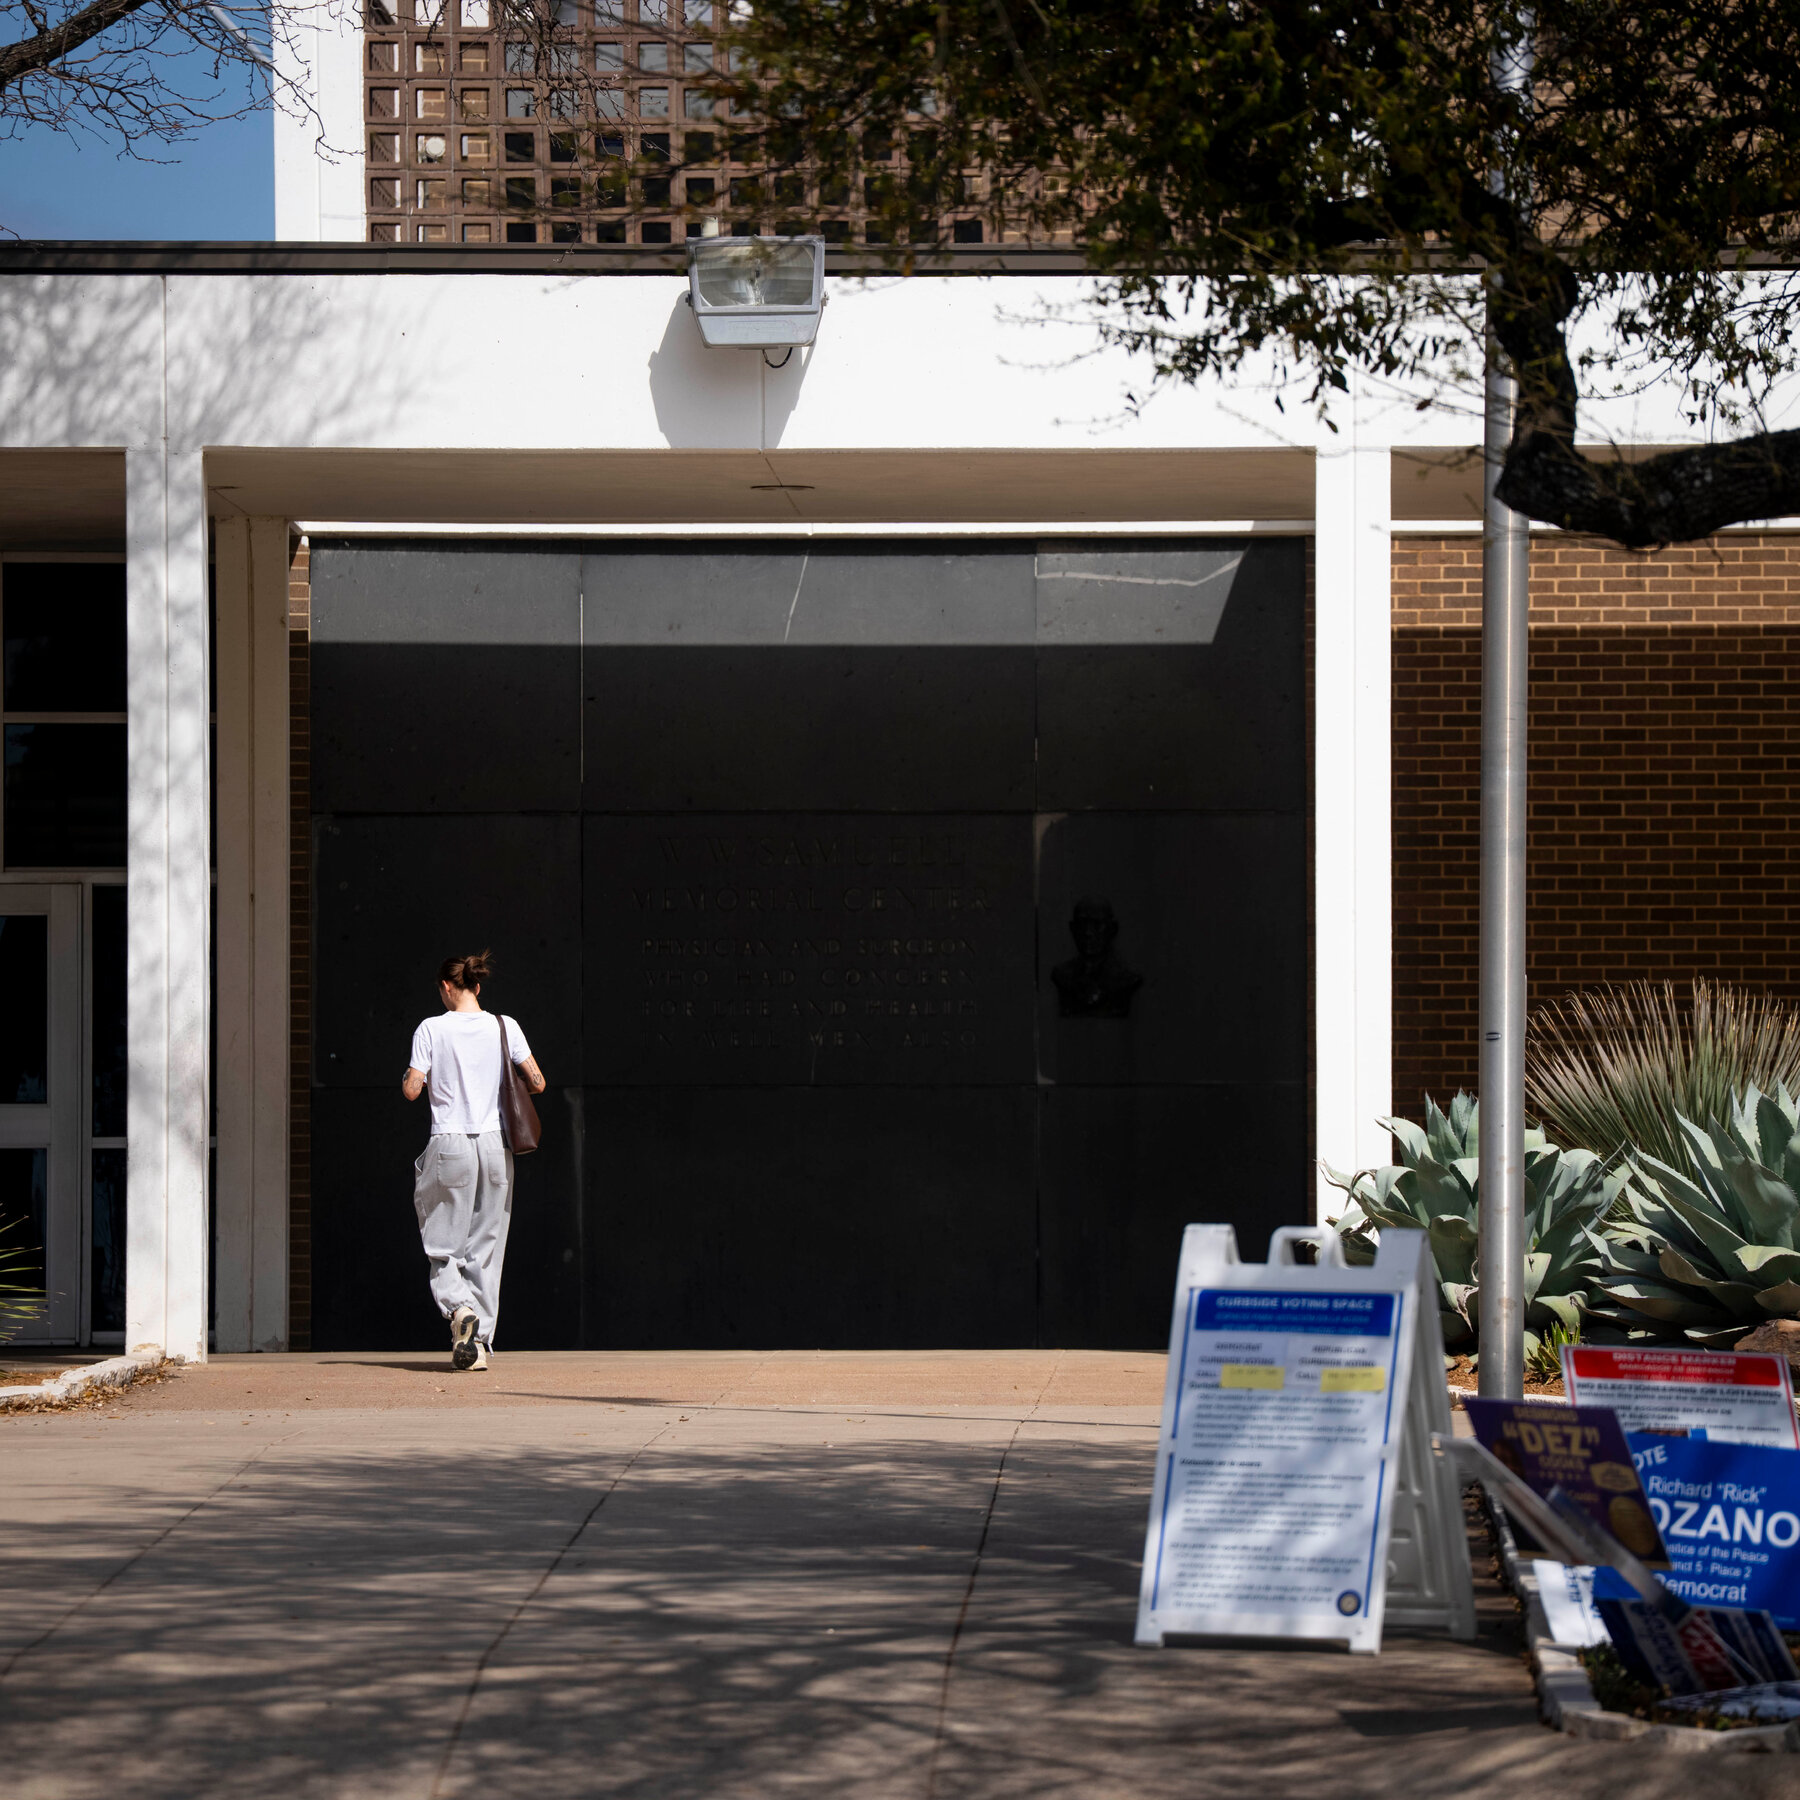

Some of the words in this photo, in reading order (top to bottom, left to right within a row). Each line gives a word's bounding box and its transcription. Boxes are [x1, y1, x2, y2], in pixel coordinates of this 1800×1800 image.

[657, 835, 688, 866] W
[704, 835, 738, 866] W
[757, 835, 967, 867] SAMUELL
[631, 886, 824, 912] MEMORIAL
[842, 886, 993, 913] CENTER
[640, 937, 774, 957] PHYSICIAN
[790, 937, 842, 957] AND
[857, 937, 977, 958] SURGEON
[642, 968, 711, 986] WHO
[736, 968, 797, 986] HAD
[821, 968, 976, 987] CONCERN
[640, 999, 696, 1017] FOR
[713, 999, 772, 1017] LIFE
[790, 999, 848, 1017] AND
[865, 999, 979, 1017] HEALTH
[640, 1030, 674, 1048] IN
[702, 1030, 781, 1048] WELL
[809, 1030, 873, 1049] MEN
[902, 1030, 979, 1049] ALSO
[1216, 1296, 1279, 1309] CURBSIDE
[1281, 1297, 1330, 1310] VOTING
[1331, 1298, 1375, 1311] SPACE
[1613, 1352, 1680, 1365] DISTANCE
[1681, 1353, 1737, 1366] MARKER
[1502, 1420, 1600, 1457] “DEZ”
[1631, 1444, 1668, 1472] OTE
[1648, 1475, 1713, 1499] Richard
[1716, 1482, 1767, 1504] “Rick”
[1648, 1497, 1800, 1548] OZANO
[1697, 1544, 1710, 1556] of
[1711, 1546, 1730, 1558] the
[1732, 1547, 1769, 1562] Peace
[1695, 1560, 1704, 1574] 5
[1709, 1561, 1742, 1577] Place
[1743, 1565, 1753, 1579] 2
